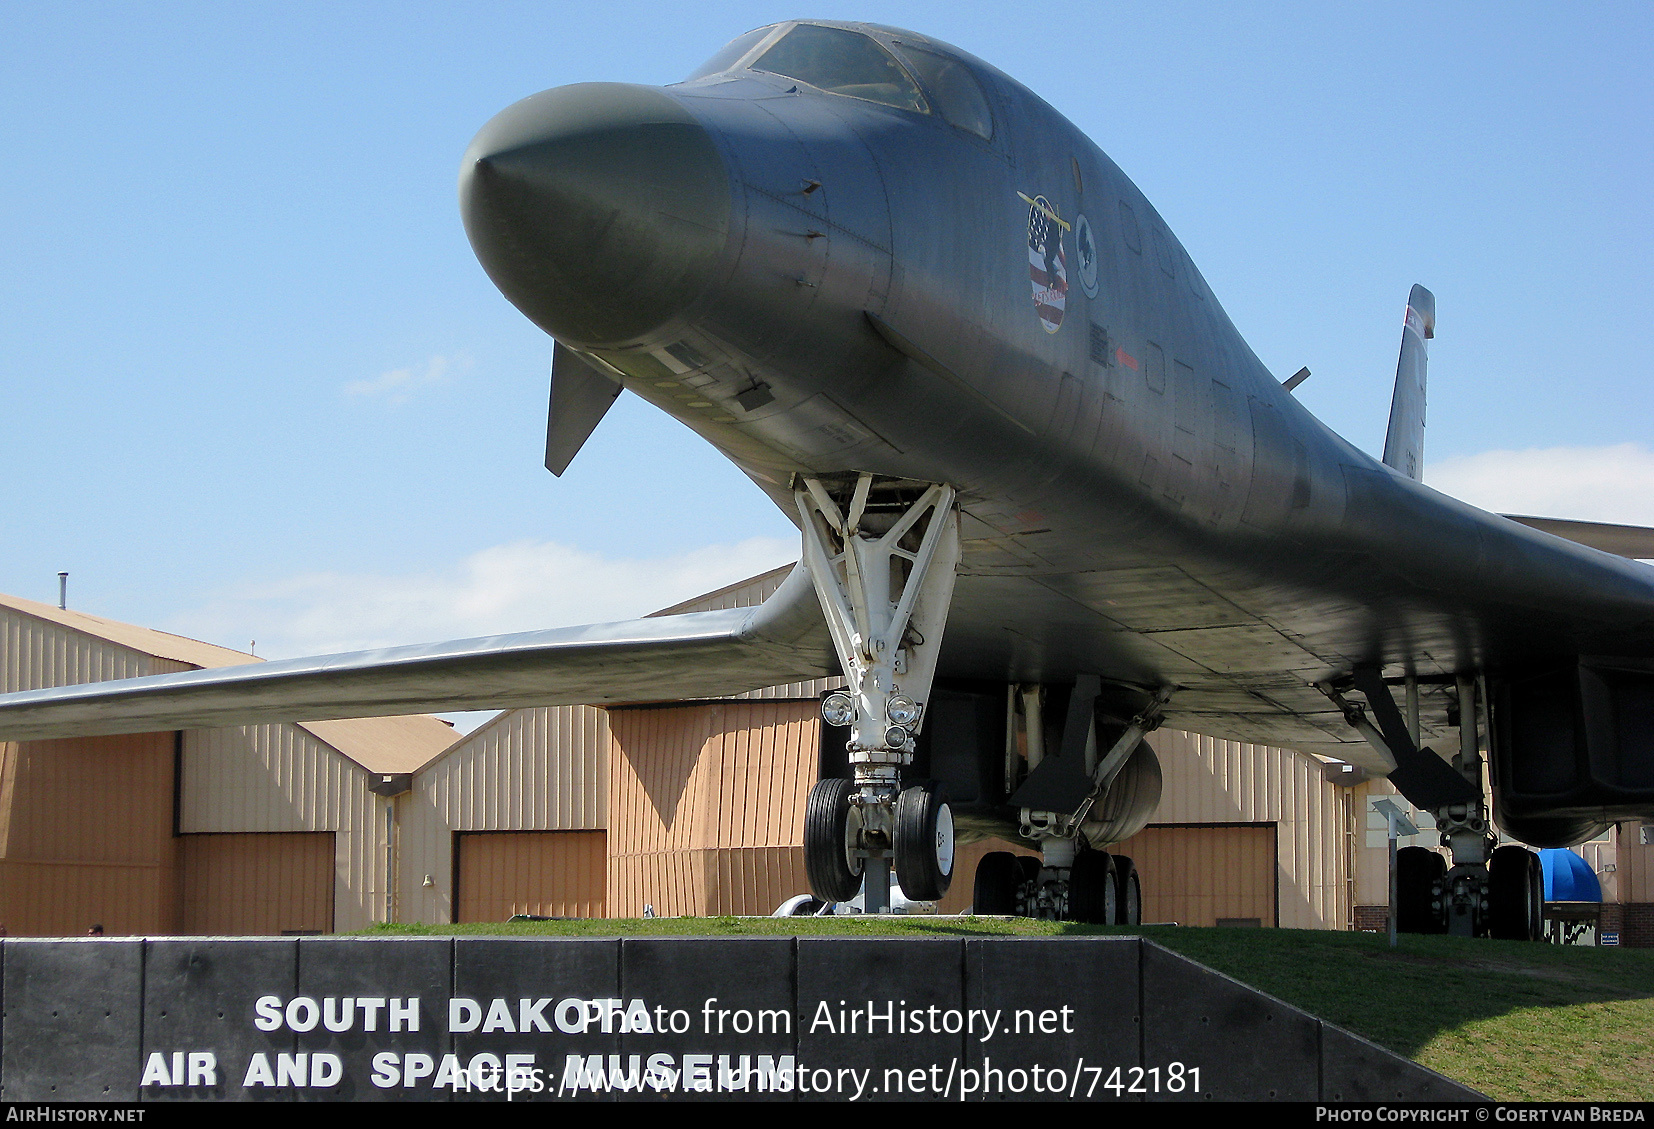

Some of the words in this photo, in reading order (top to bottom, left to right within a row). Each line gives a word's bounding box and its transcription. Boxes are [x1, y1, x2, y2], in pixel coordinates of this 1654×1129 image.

[255, 996, 420, 1033] SOUTH
[449, 997, 654, 1033] DAKOTA
[140, 1053, 217, 1087] AIR
[242, 1053, 343, 1088] AND
[371, 1052, 535, 1089] SPACE
[566, 1053, 796, 1090] MUSEUM
